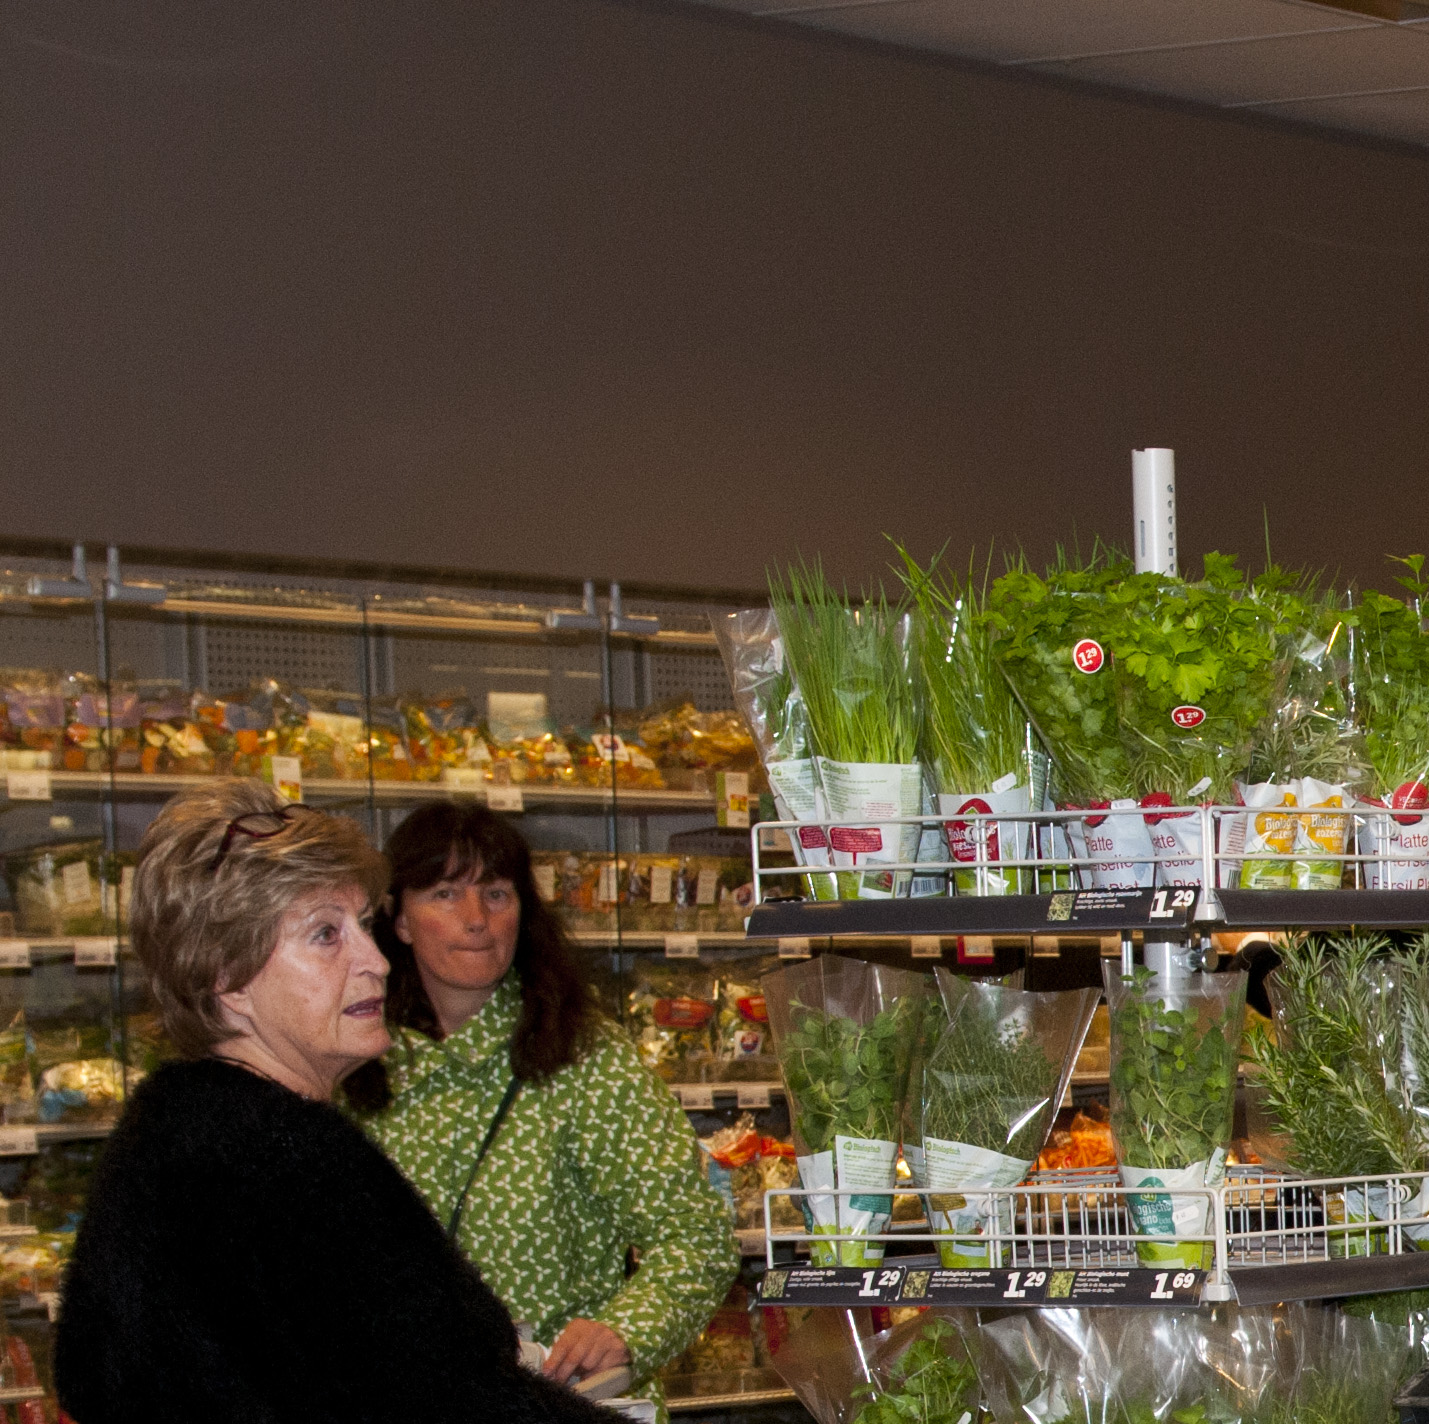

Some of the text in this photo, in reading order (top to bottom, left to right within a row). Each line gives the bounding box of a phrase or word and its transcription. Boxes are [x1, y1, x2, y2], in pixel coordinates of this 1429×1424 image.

[1150, 890, 1195, 918] 1.29
[859, 1270, 900, 1297] 1.29
[1003, 1271, 1047, 1298] 1.29
[1150, 1272, 1195, 1299] 1.69
